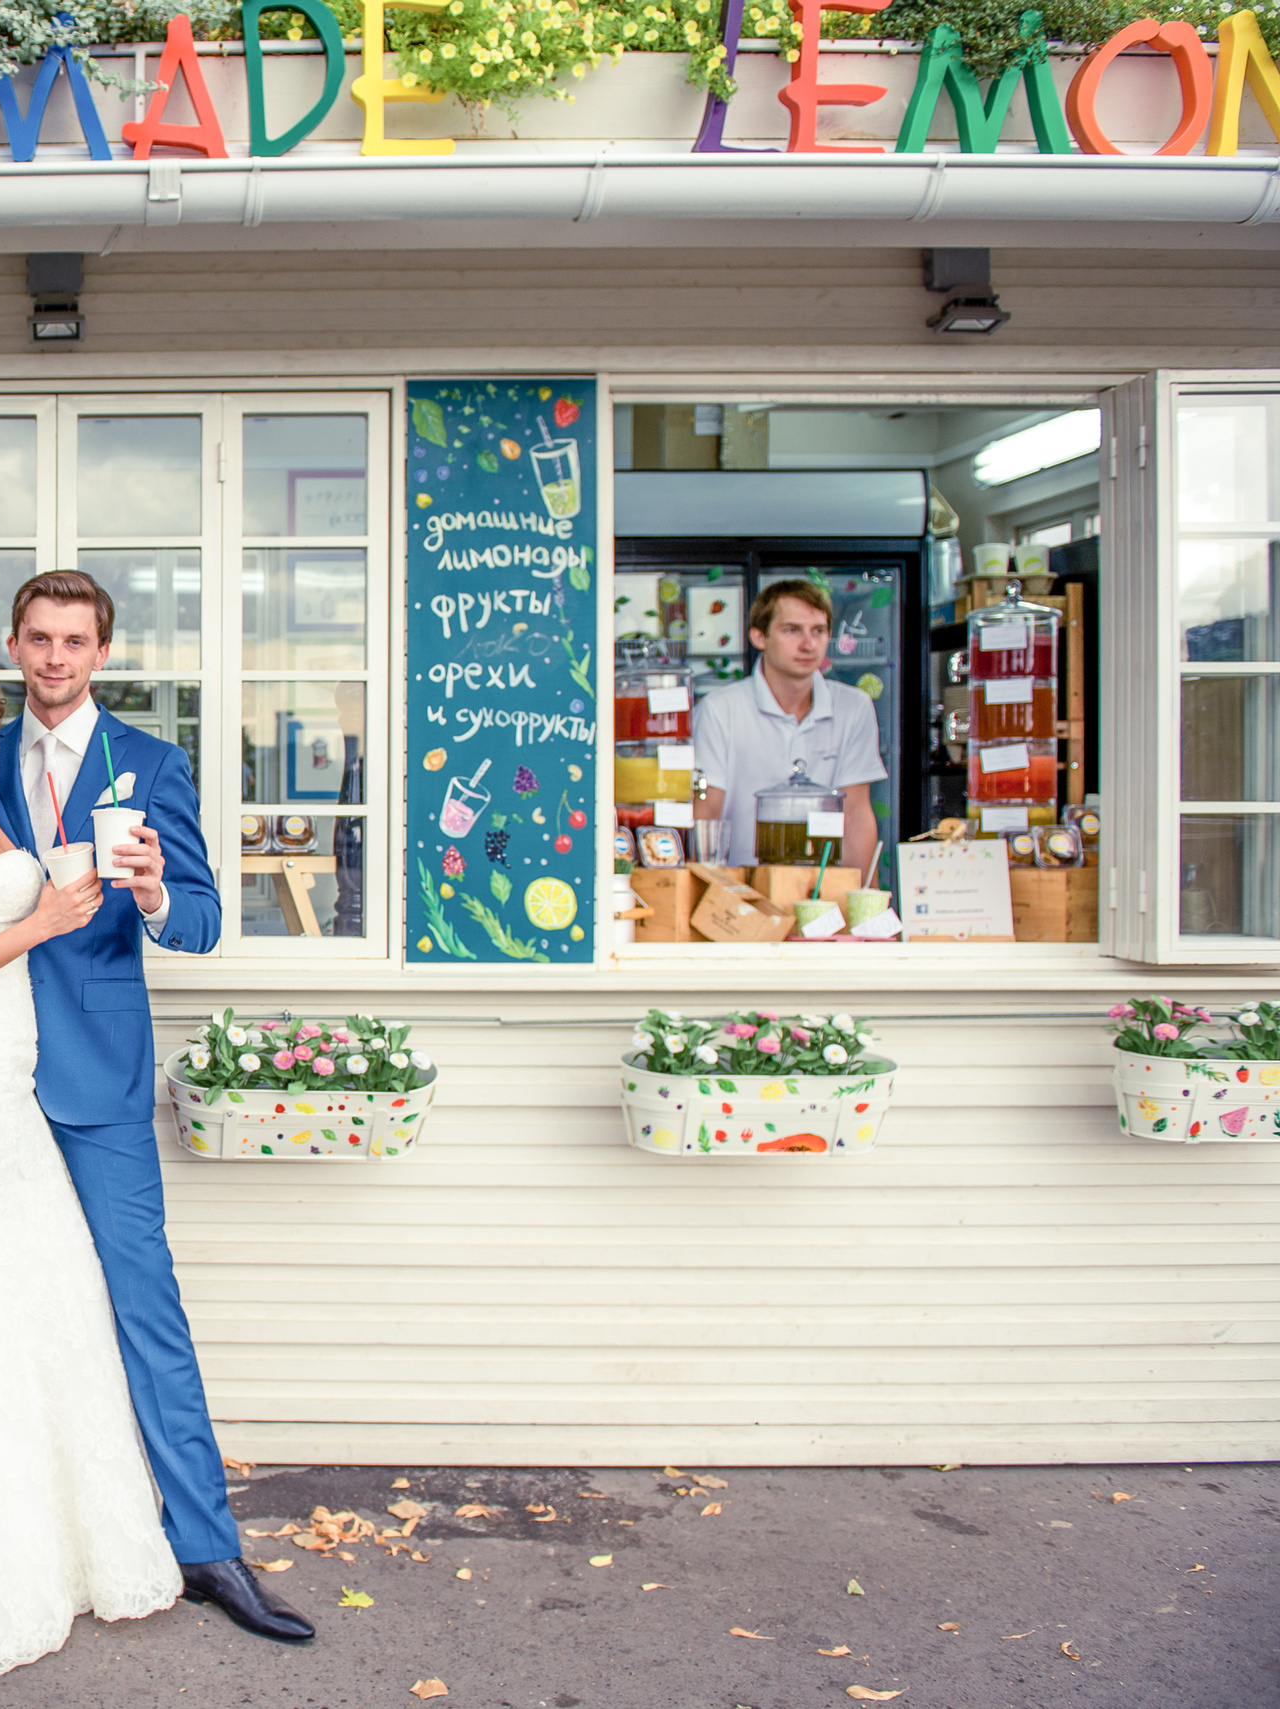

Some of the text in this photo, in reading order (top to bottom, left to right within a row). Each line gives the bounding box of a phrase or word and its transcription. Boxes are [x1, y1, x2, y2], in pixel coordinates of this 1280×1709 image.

[423, 510, 573, 552] домашние
[437, 544, 587, 579] лимонады
[430, 588, 552, 639] фрукты
[428, 661, 537, 699] орехи
[427, 704, 597, 747] и сухофрукты
